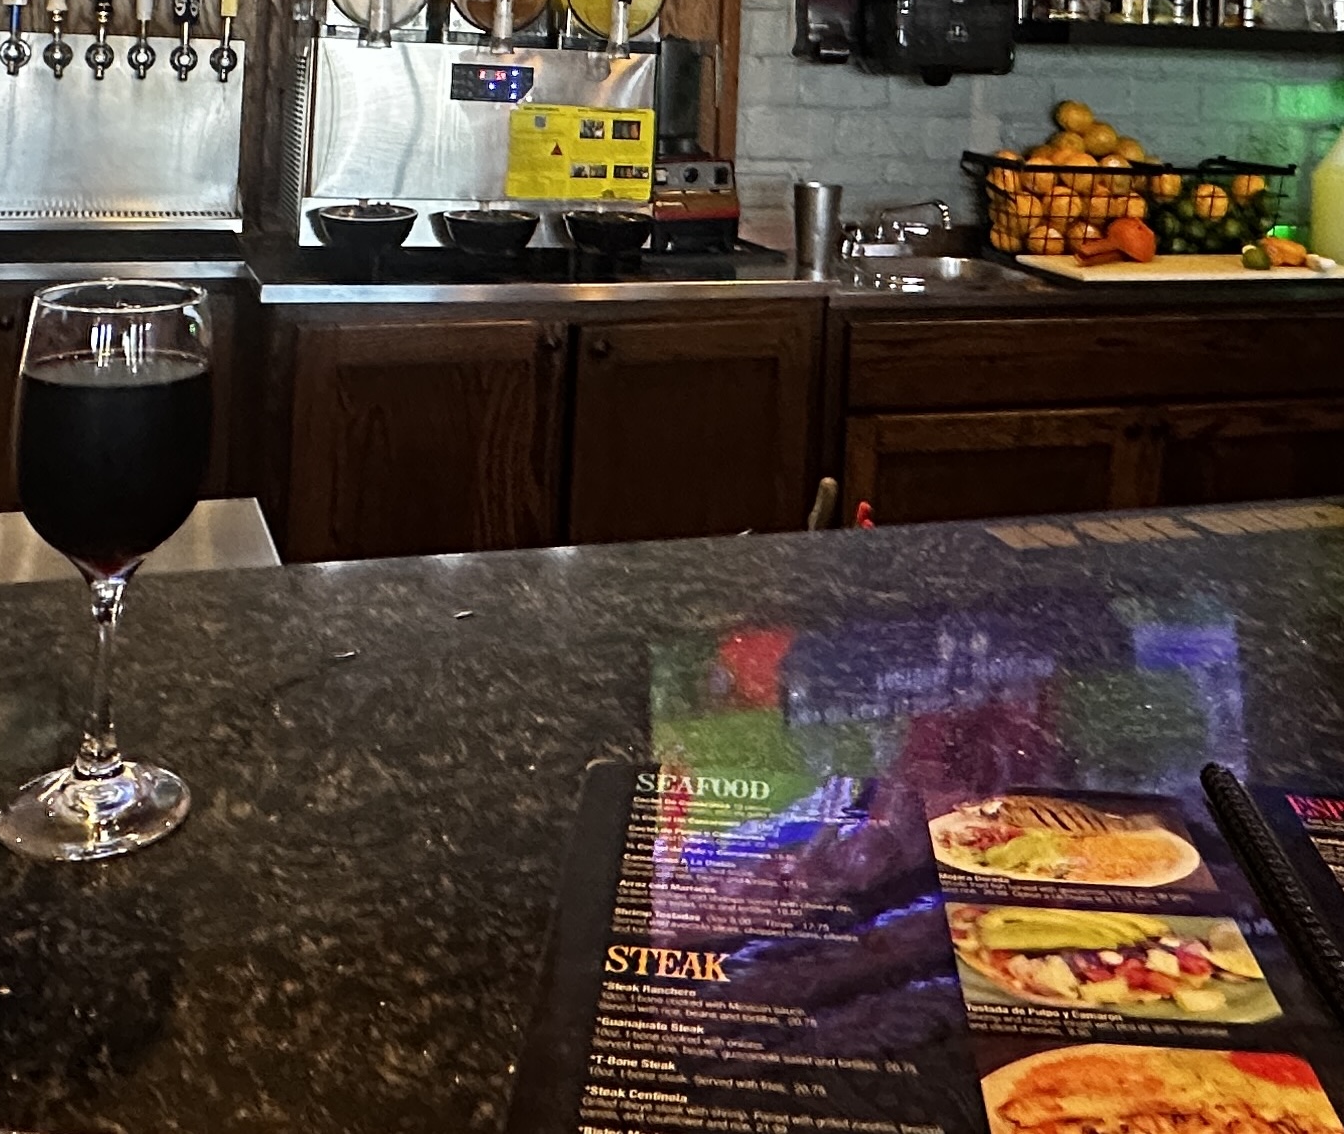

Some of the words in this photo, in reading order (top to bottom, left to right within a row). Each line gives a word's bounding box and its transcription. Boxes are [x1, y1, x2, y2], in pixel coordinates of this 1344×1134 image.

[635, 772, 771, 800] SEAFOOD
[605, 945, 731, 983] STEAK
[1011, 1006, 1027, 1016] de
[670, 1022, 705, 1035] Steak
[641, 1059, 676, 1072] Steak
